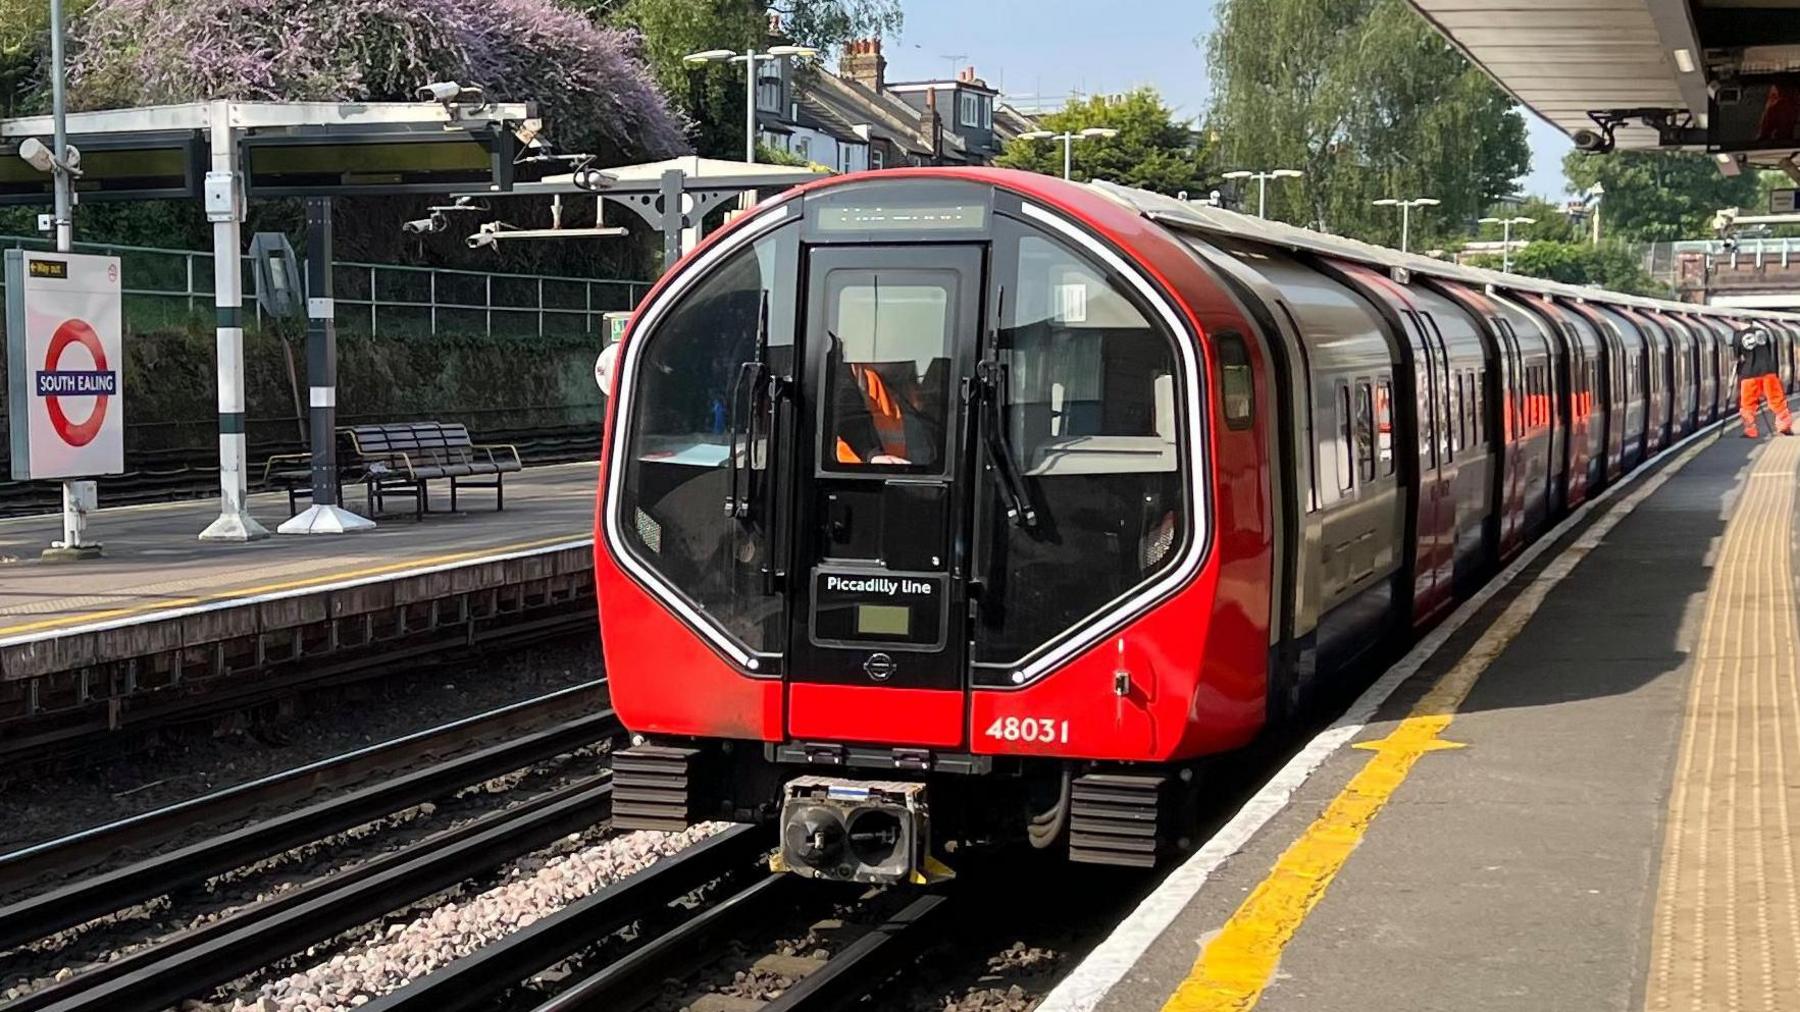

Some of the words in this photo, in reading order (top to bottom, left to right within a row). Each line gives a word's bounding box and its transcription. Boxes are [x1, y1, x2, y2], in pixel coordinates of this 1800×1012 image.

[40, 376, 75, 391] SOUTH
[77, 376, 113, 391] EALING
[827, 577, 898, 595] Piccadilly
[902, 580, 931, 594] line
[985, 716, 1068, 743] 48031
